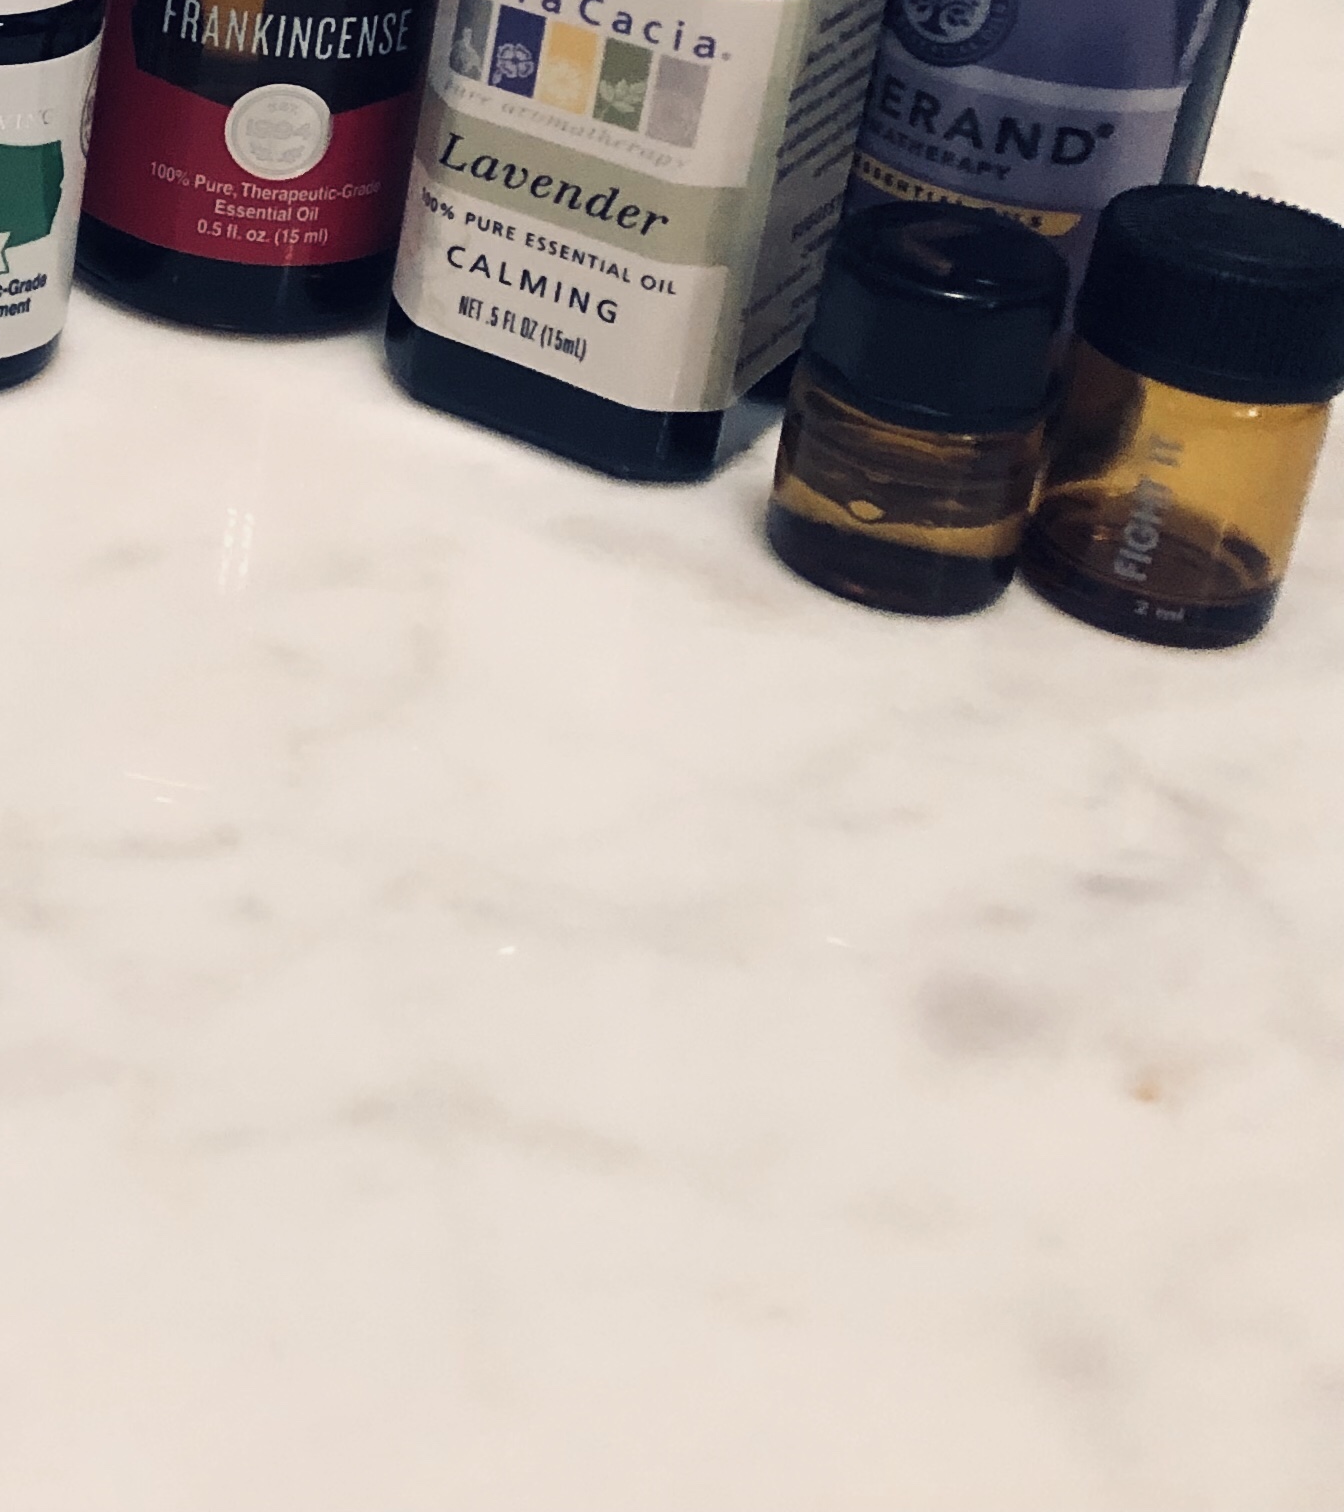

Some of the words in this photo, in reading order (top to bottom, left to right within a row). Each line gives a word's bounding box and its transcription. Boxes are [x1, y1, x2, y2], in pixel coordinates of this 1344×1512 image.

[878, 74, 1096, 165] ERAND
[150, 161, 189, 187] 100%
[195, 175, 238, 204] Pure,
[241, 180, 380, 207] Therapeutic-Grade
[215, 199, 291, 222] Essential
[297, 205, 320, 222] Oil
[439, 132, 670, 237] Lavender
[197, 219, 222, 237] 0.5
[275, 227, 299, 247] (15
[464, 212, 515, 242] PURE
[525, 232, 631, 284] ESSENTIAL
[640, 273, 677, 296] OIL
[446, 245, 619, 324] CALMING
[458, 294, 482, 323] NET
[485, 306, 500, 329] .5
[503, 310, 516, 334] FL
[520, 316, 537, 340] OZ
